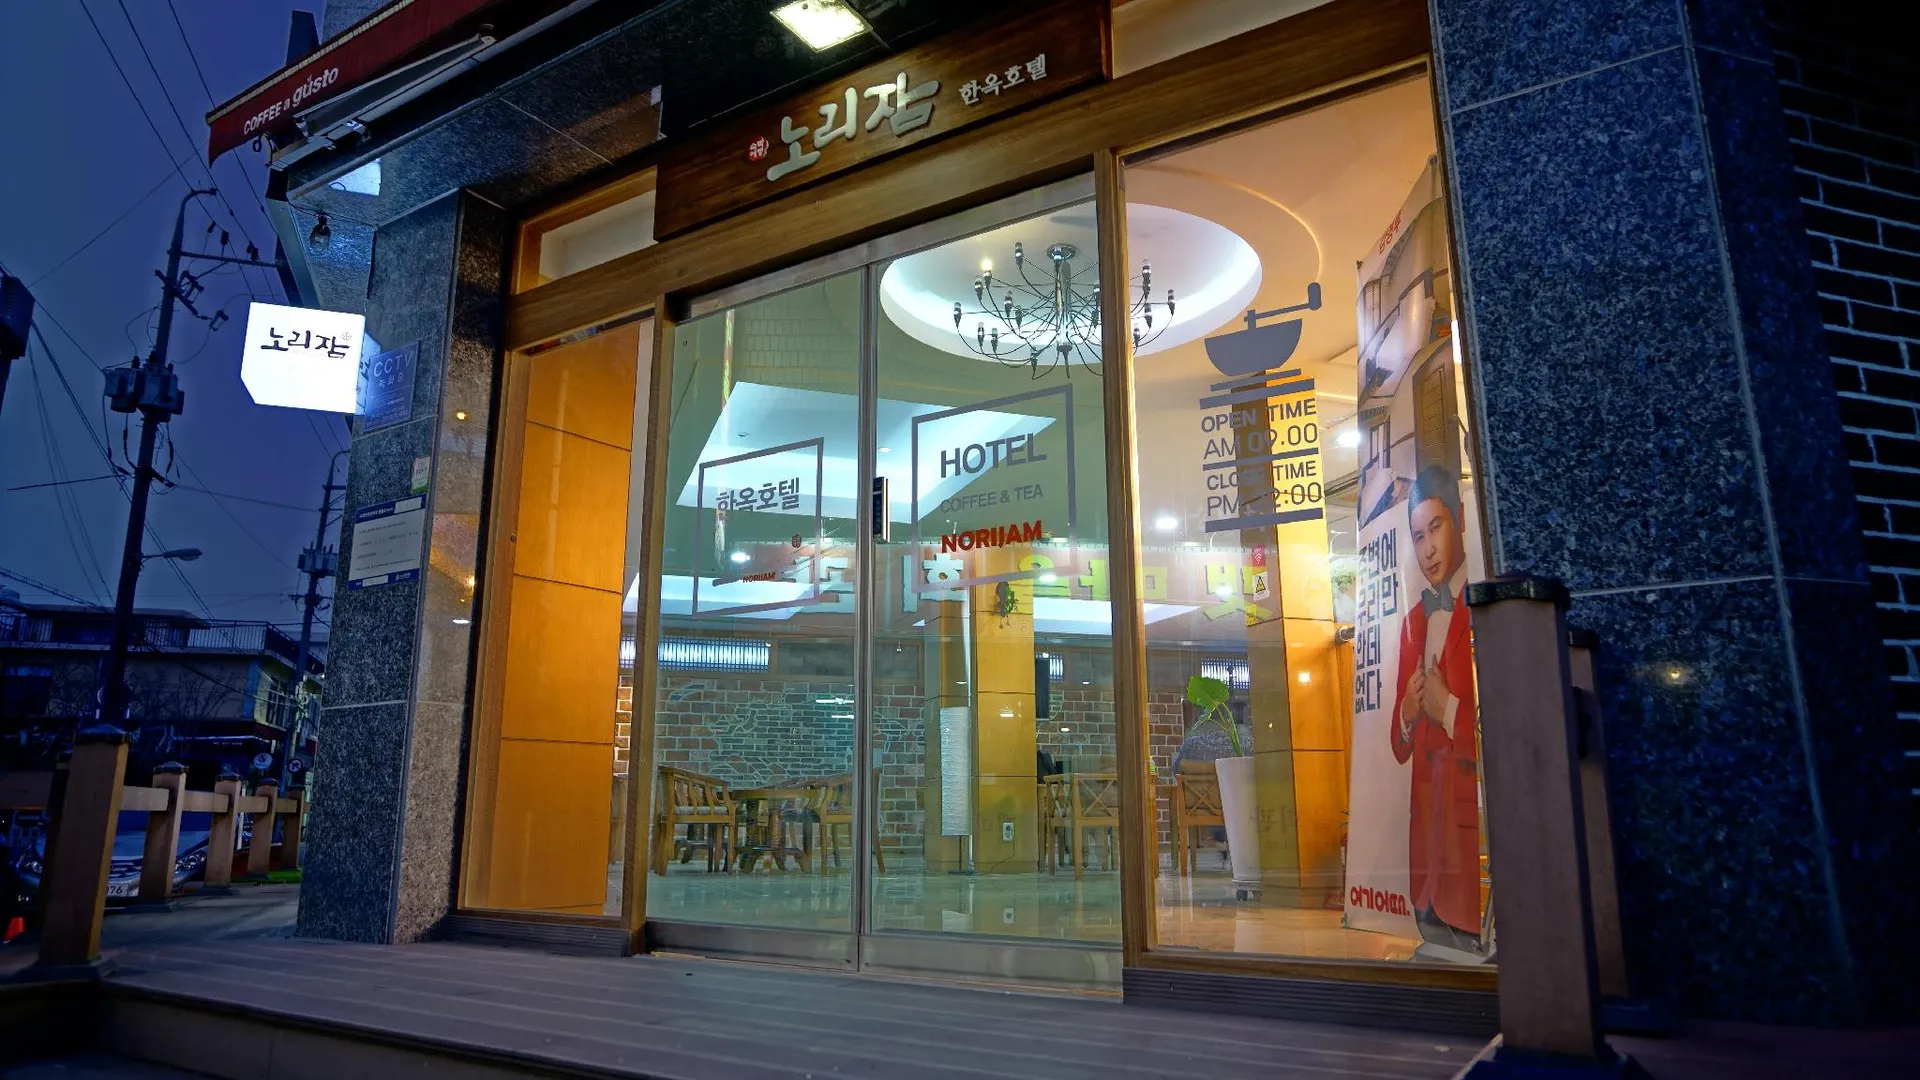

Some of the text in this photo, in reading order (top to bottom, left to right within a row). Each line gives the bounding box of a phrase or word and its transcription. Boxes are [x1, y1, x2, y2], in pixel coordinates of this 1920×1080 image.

[958, 52, 1048, 106] 한옥호텔
[243, 101, 283, 135] COFFEE
[283, 97, 291, 111] a
[373, 350, 415, 378] CCTV
[1201, 397, 1317, 433] OPEN TIME
[940, 432, 1048, 479] HOTEL
[1203, 436, 1242, 460] AM
[1273, 460, 1317, 481] TIME
[715, 477, 800, 521] 한옥호텔
[940, 483, 1044, 514] COFFEE & TEA
[1207, 493, 1241, 517] PM
[940, 520, 1043, 553] NORIJAM
[1358, 527, 1397, 587] 주변에
[742, 571, 776, 584] NORIJAM
[1357, 572, 1399, 627] 우리만
[1355, 623, 1381, 671] 한데
[1355, 669, 1382, 715] 없다
